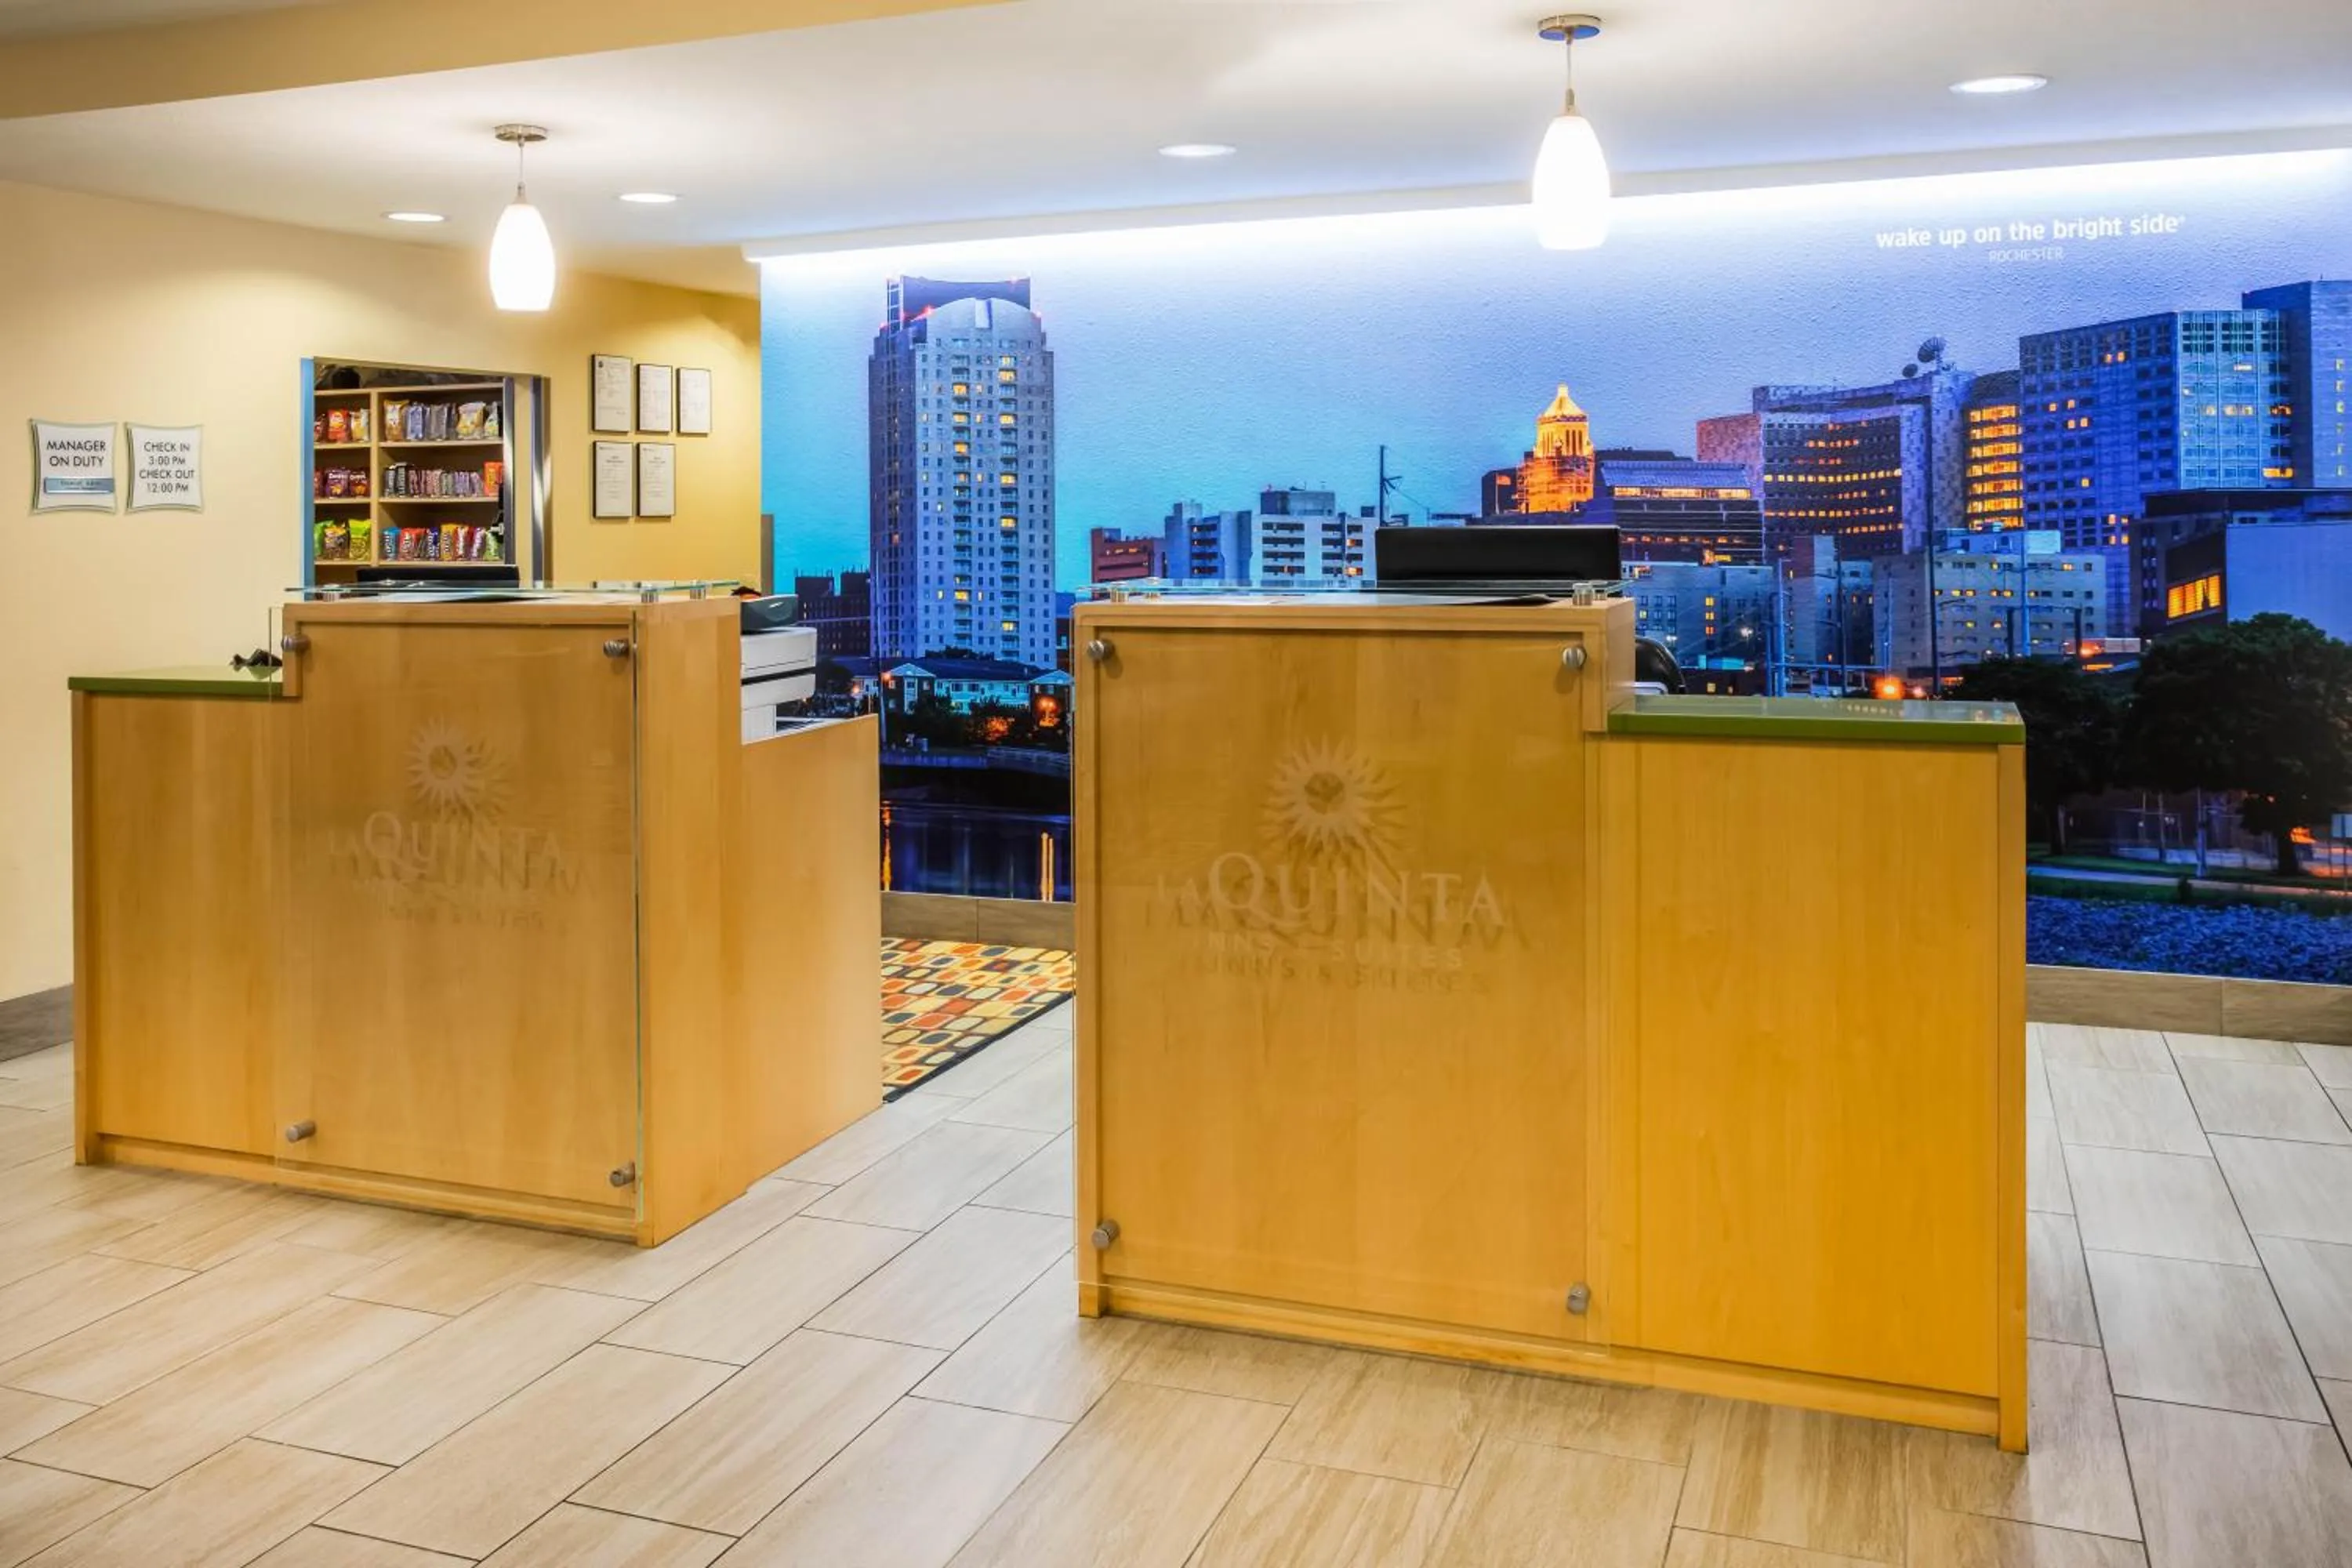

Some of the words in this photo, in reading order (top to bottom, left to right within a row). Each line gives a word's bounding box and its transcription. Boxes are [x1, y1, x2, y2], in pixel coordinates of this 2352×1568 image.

[1876, 227, 1932, 249] wake
[1939, 227, 1966, 249] up
[1974, 225, 2001, 243] on
[2009, 220, 2045, 241] the
[2053, 216, 2123, 241] bright
[1988, 246, 2064, 263] ROCHESTER
[46, 440, 107, 452] MANAGER
[143, 441, 177, 452] CHECK
[180, 442, 191, 452] IN
[49, 456, 70, 467] ON
[73, 456, 105, 468] DUTY
[148, 455, 169, 466] 3:00
[172, 456, 186, 466] PM
[139, 468, 172, 480] CHECK
[175, 469, 195, 480] OUT
[147, 482, 172, 494] 12:00
[174, 482, 190, 493] PM
[364, 811, 561, 876] QUINTA
[1207, 851, 1504, 928] QUINTA
